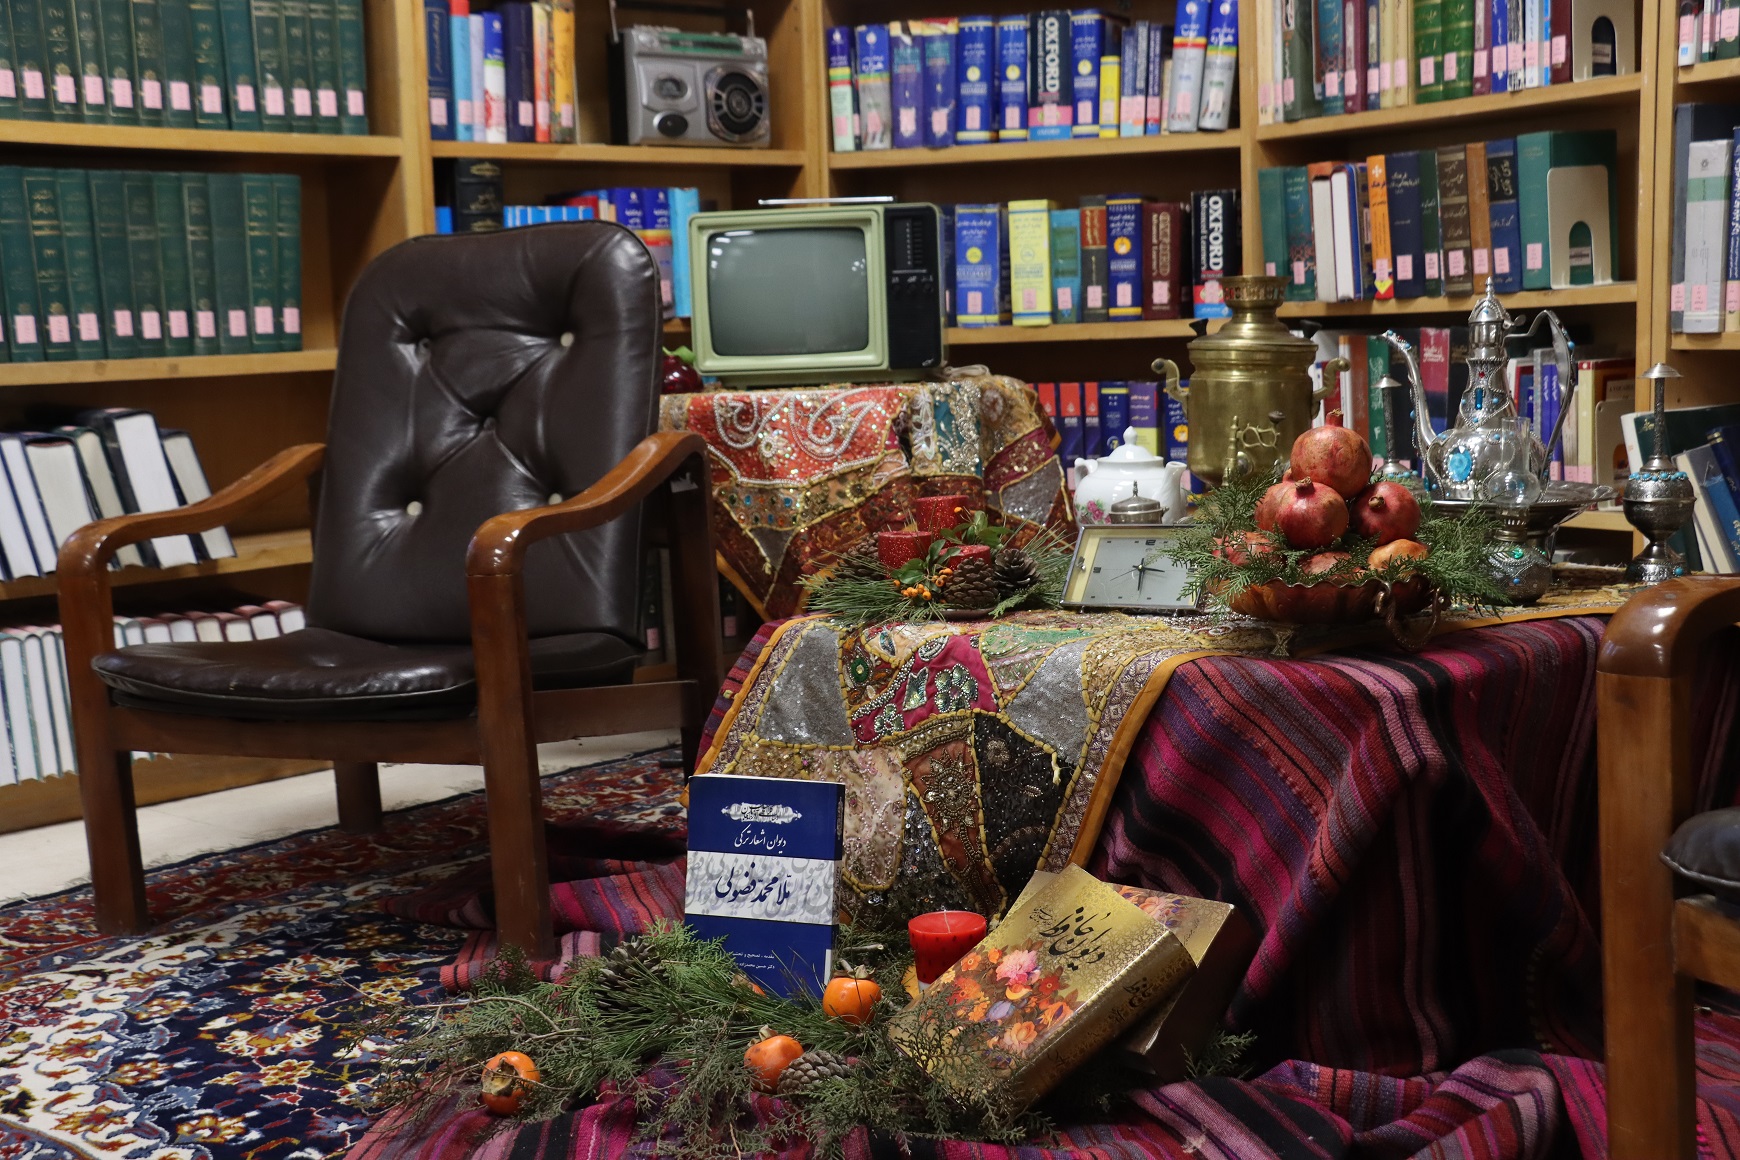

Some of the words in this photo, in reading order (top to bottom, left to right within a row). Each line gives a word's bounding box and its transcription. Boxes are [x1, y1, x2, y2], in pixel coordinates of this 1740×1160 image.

[1045, 16, 1060, 92] OXFORD
[1209, 196, 1224, 270] OXFORD
[734, 824, 751, 848] ترکی
[750, 828, 766, 848] اشعار
[766, 834, 786, 854] دیوان
[715, 862, 756, 904] فضولی
[1039, 906, 1099, 938] حافظ
[1049, 928, 1112, 971] دیوان
